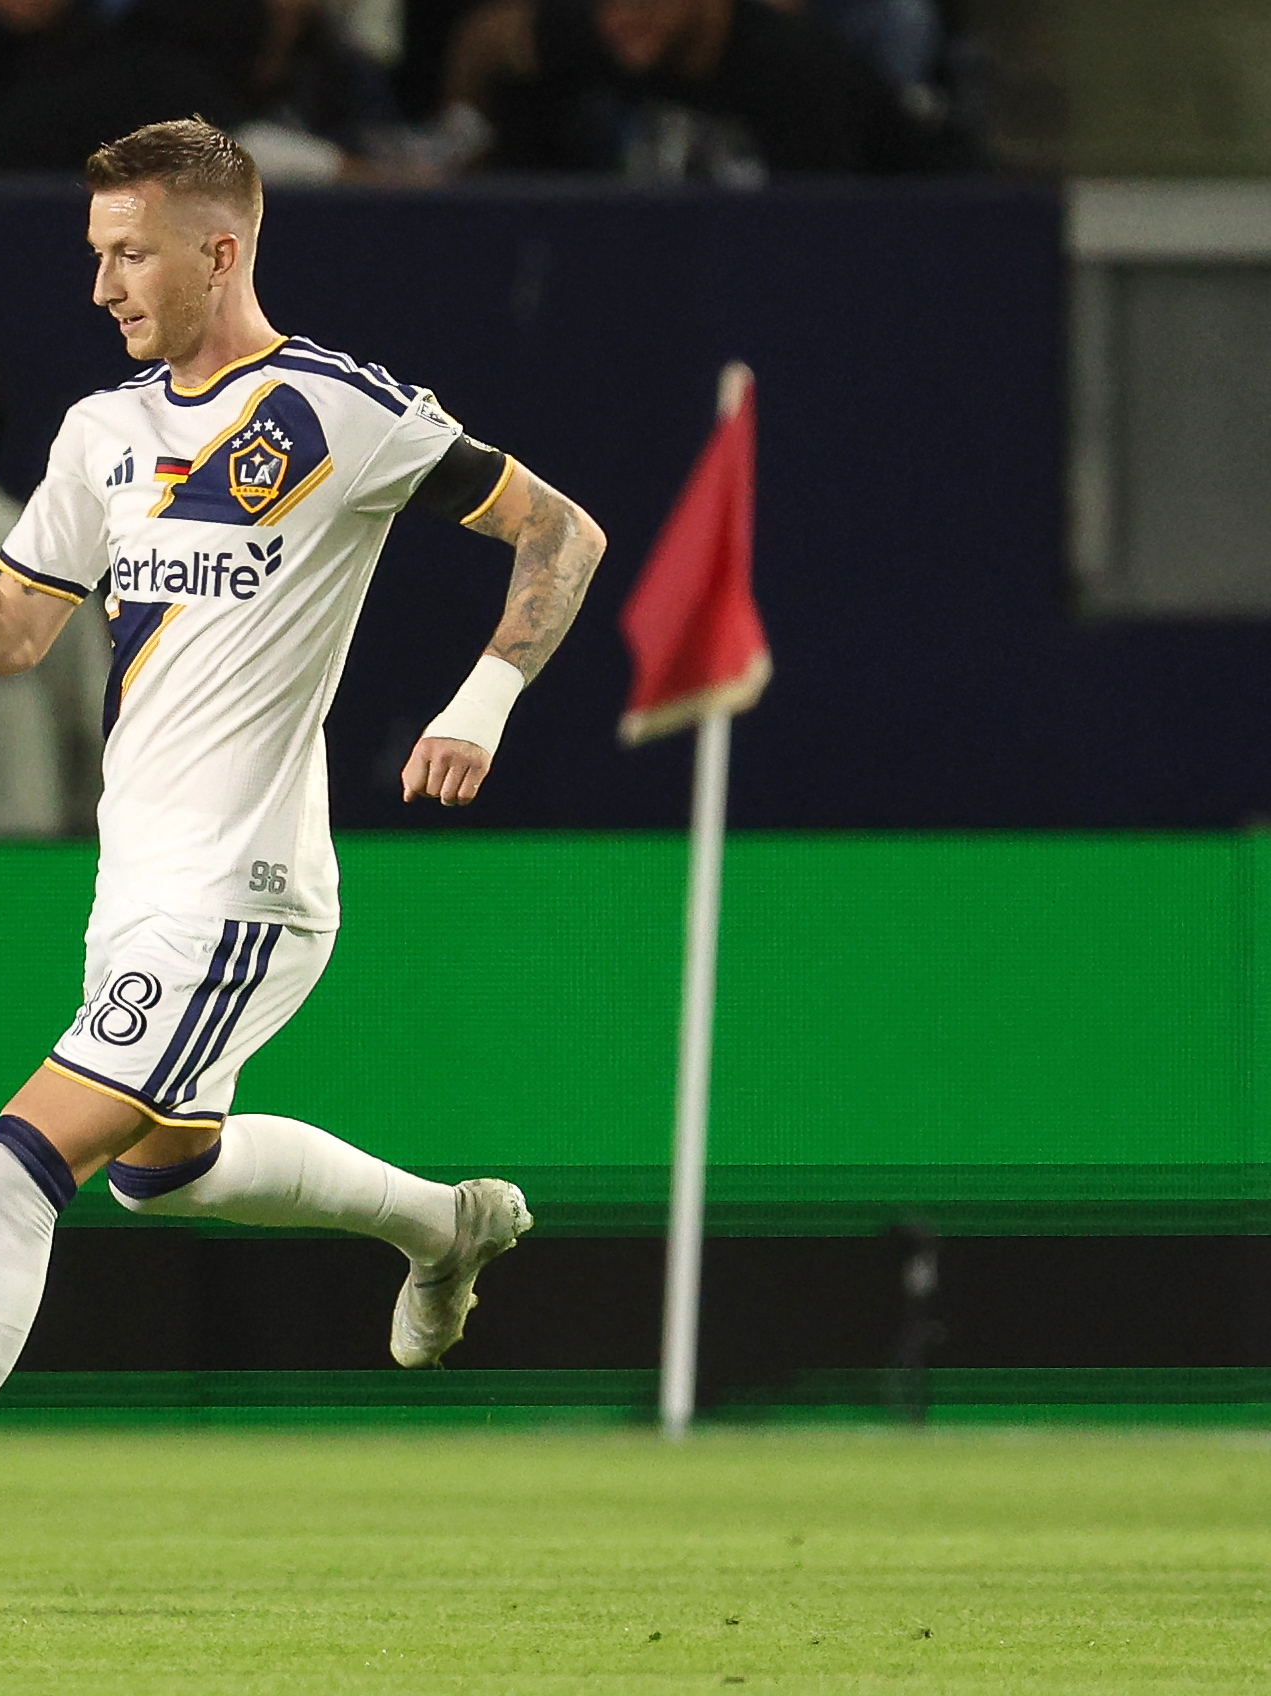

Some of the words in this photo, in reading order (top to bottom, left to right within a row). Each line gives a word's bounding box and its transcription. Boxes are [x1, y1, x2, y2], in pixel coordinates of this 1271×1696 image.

[240, 464, 272, 485] LA
[112, 546, 260, 600] erbalife
[249, 860, 288, 894] 96
